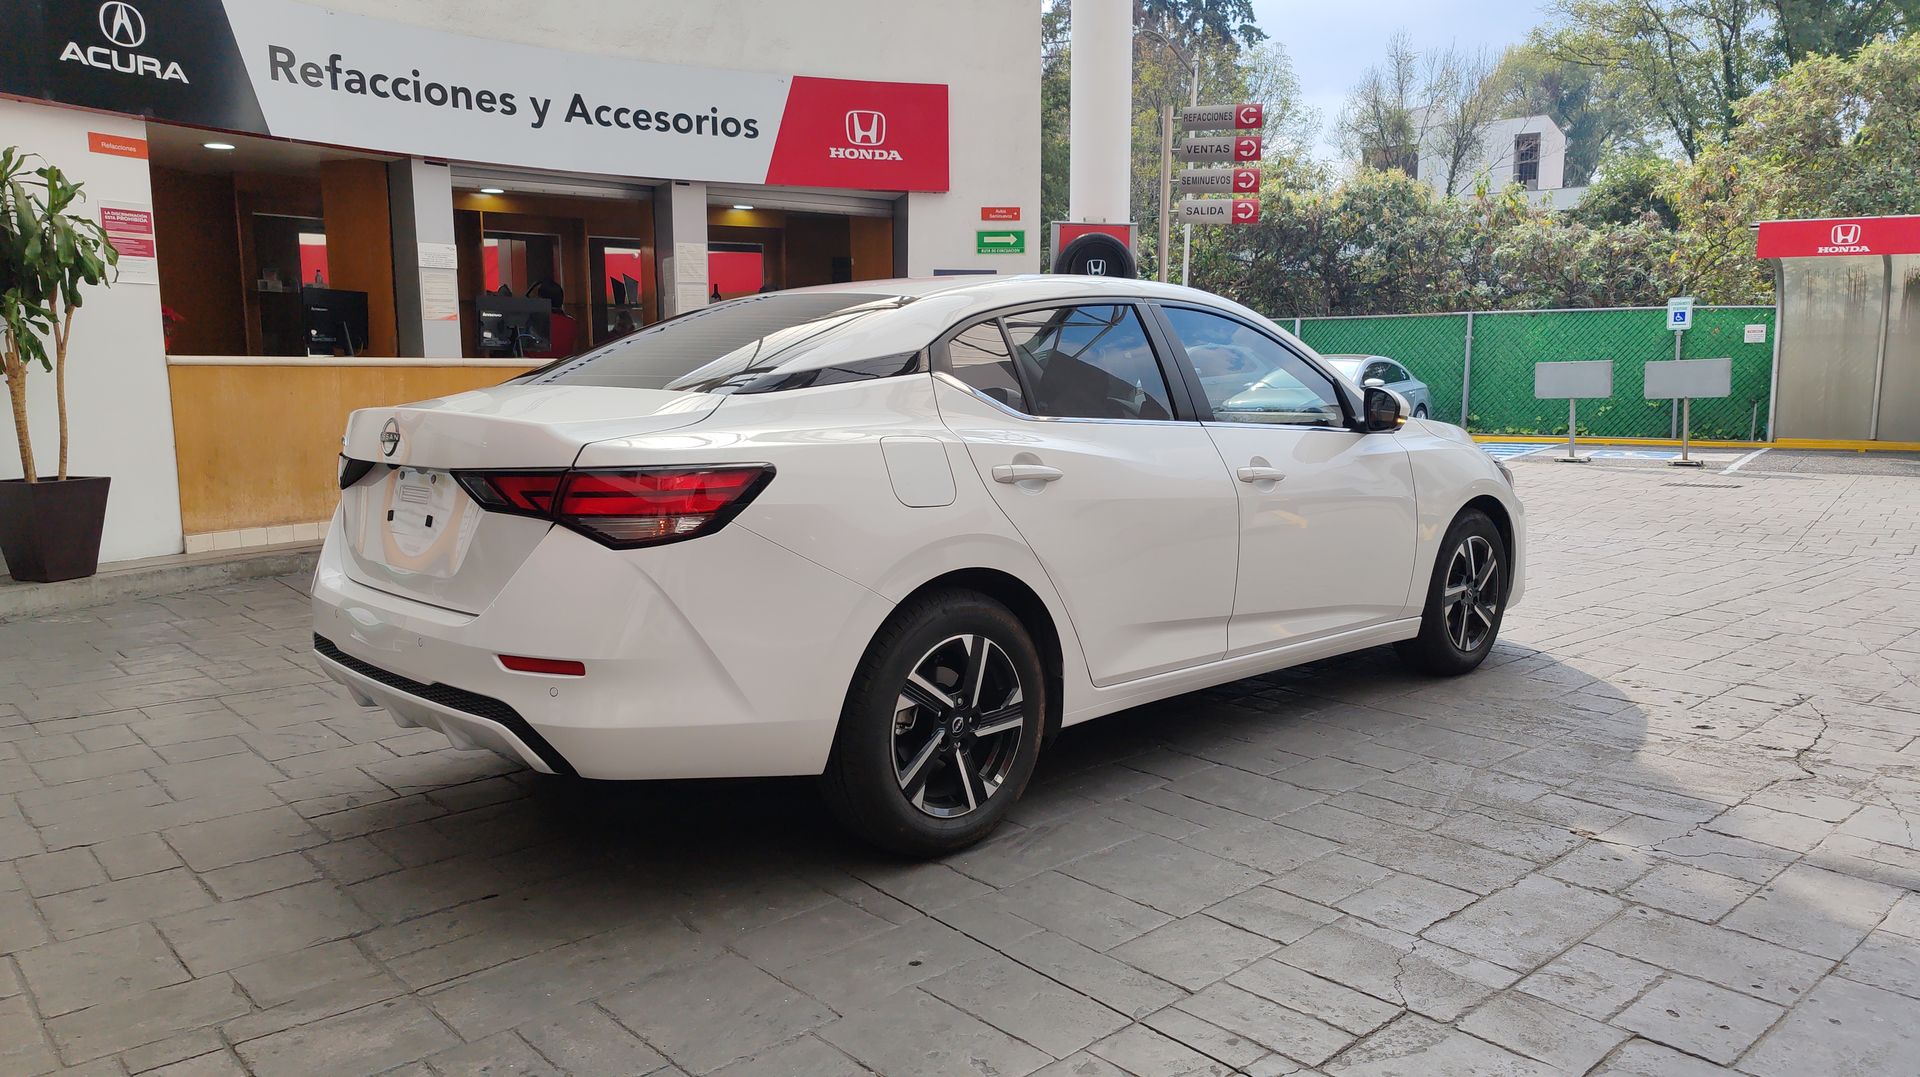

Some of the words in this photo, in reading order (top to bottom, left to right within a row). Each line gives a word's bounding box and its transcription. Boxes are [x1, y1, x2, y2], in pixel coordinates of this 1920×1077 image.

[59, 41, 190, 84] ACURA
[268, 44, 518, 116] Refacciones
[529, 96, 551, 129] y
[564, 93, 760, 139] Accesorios
[1183, 111, 1233, 122] REFACCIONES
[101, 141, 137, 152] Refacciones
[1186, 144, 1230, 154] VENTAS
[829, 147, 903, 161] HONDA
[1181, 175, 1231, 185] SEMINUEVOS
[1186, 206, 1224, 215] SALIDA
